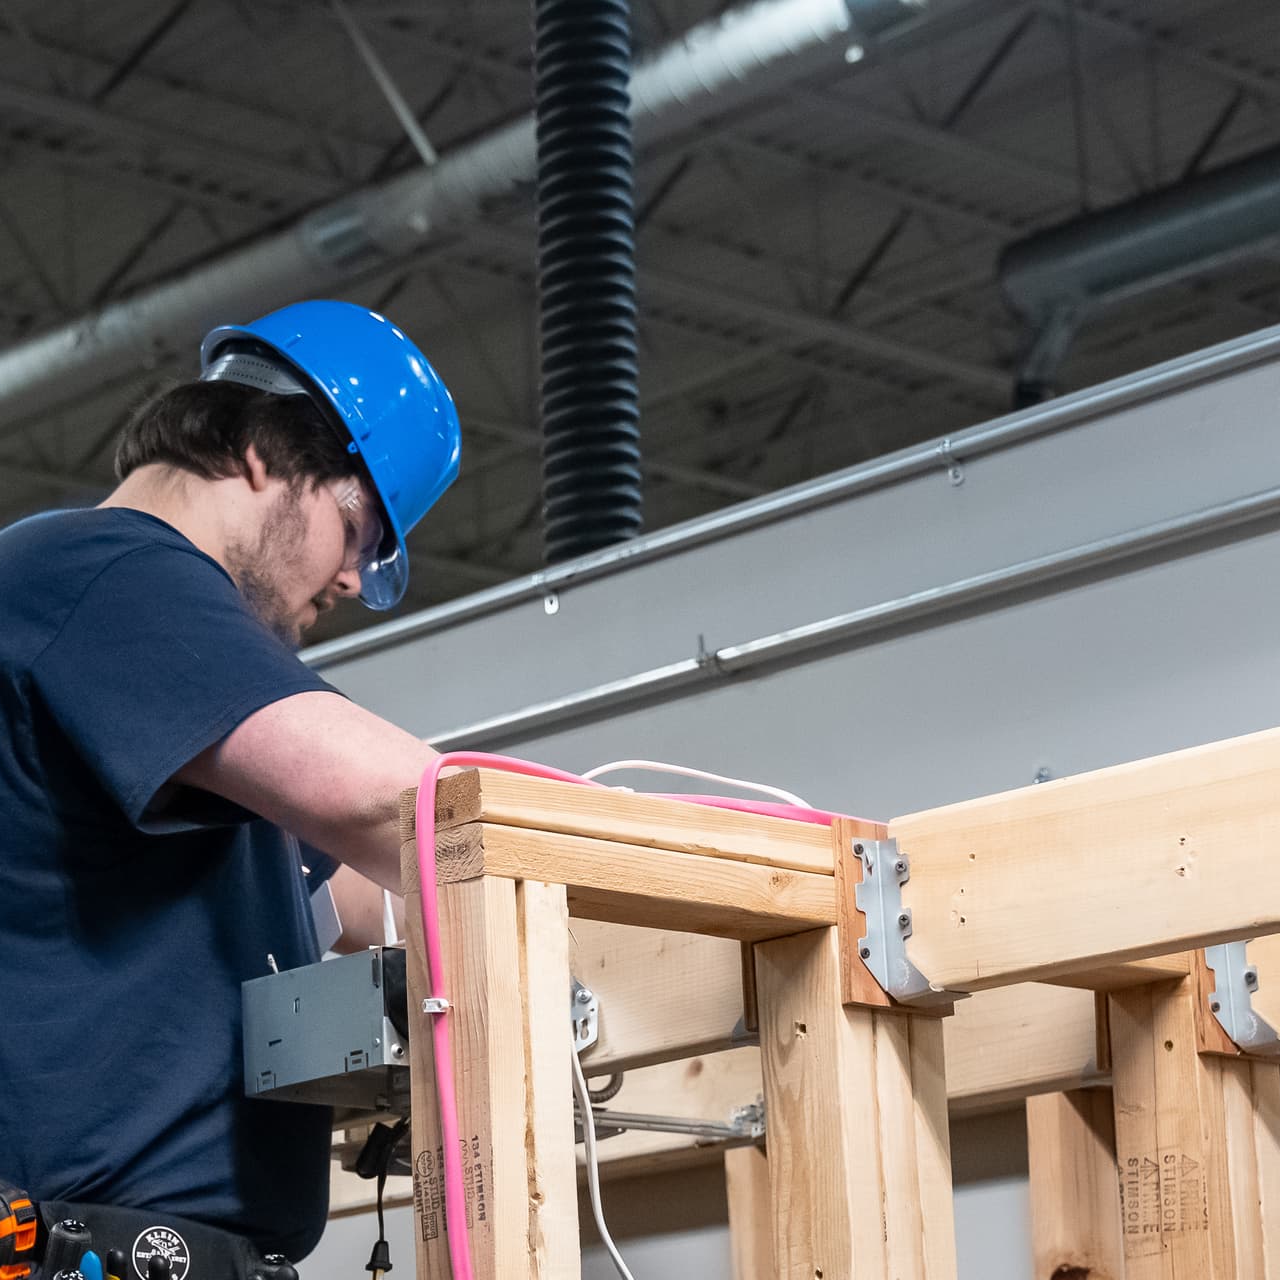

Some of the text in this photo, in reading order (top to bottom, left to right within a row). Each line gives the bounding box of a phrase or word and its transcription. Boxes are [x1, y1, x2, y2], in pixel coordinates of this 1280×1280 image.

[429, 1176, 440, 1210] STUD
[1127, 1157, 1140, 1234] STIMSON
[1163, 1154, 1176, 1232] STIMSON
[145, 1231, 180, 1246] KLEIN
